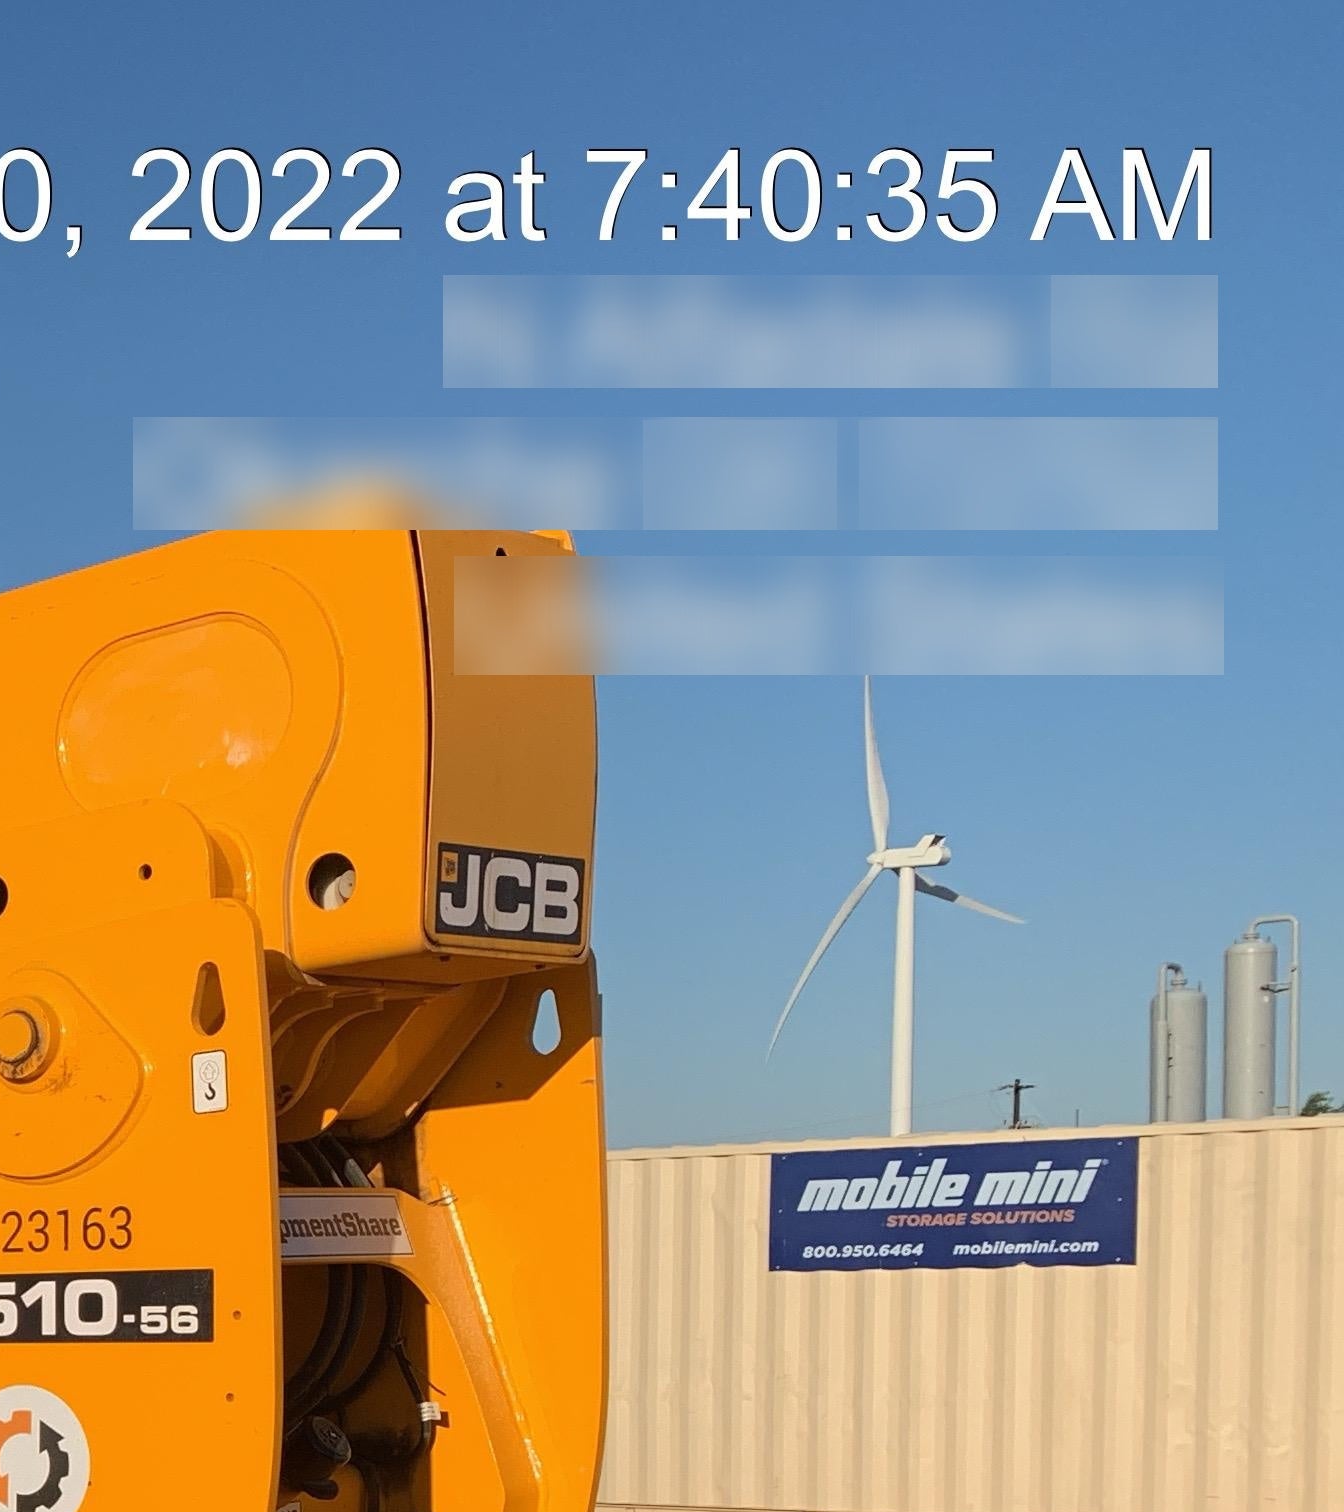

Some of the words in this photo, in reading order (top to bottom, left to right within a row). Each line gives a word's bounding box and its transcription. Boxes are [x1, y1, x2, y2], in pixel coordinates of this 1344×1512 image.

[439, 854, 579, 935] JCB
[797, 1158, 971, 1212] mobile
[973, 1159, 1102, 1206] mini
[886, 1213, 968, 1228] STORAGE
[970, 1209, 1076, 1225] SOLUTIONS
[802, 1243, 925, 1258] 800.950.6464
[953, 1240, 1100, 1256] mobilemini.com
